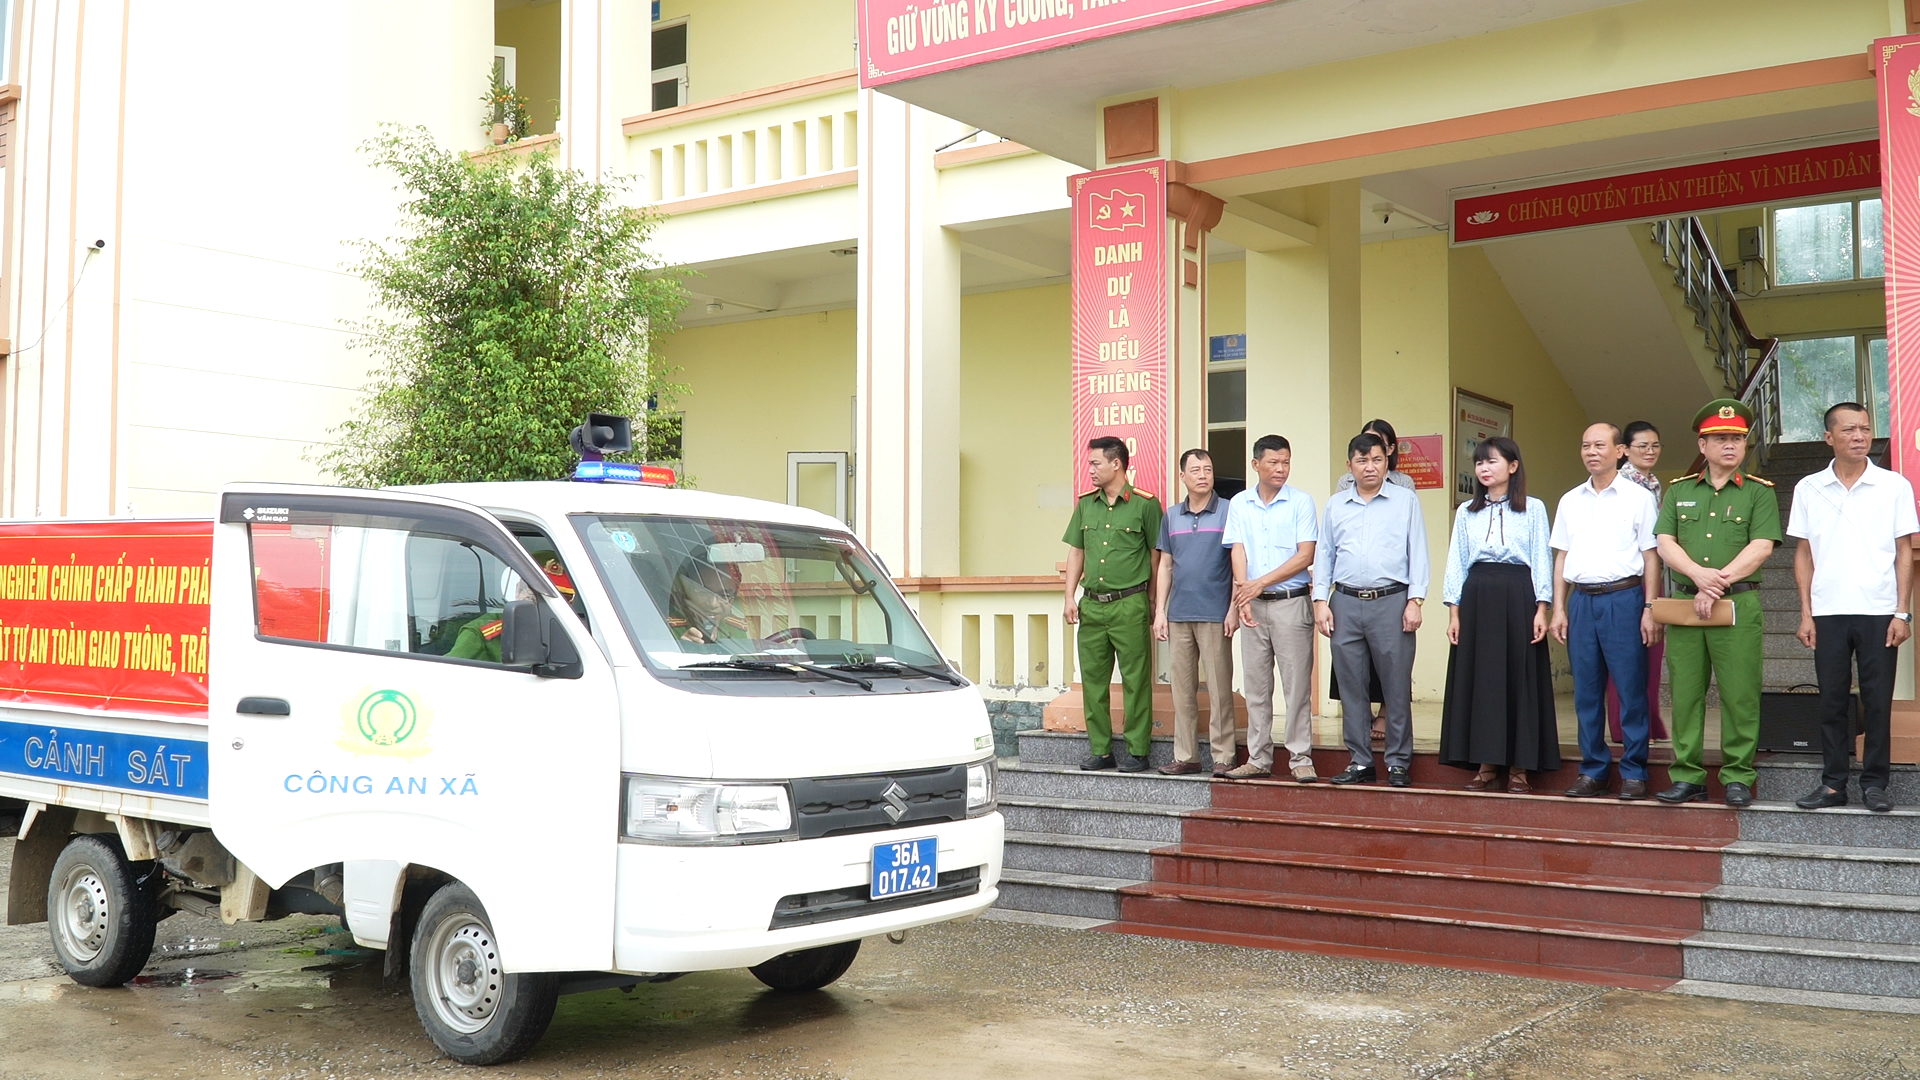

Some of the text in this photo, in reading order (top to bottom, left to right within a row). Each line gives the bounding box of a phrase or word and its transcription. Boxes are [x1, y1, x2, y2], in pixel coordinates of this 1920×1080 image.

[887, 4, 918, 55] GIỮ
[1508, 197, 1563, 222] CHÍNH
[1568, 182, 1627, 217] QUYỀN
[1631, 178, 1680, 205] THÂN
[1684, 169, 1744, 198] THIỆN,
[1750, 164, 1770, 189] VÌ
[1774, 157, 1828, 187] NHÂN
[1832, 152, 1872, 179] DÂN
[1094, 241, 1143, 266] DANH
[1107, 273, 1132, 300] DỰ
[1108, 304, 1131, 329] LÀ
[1098, 334, 1140, 362] ĐIỀU
[1088, 370, 1151, 394] THIÊNG
[1093, 402, 1145, 426] LIÊNG
[256, 507, 289, 515] SUZUKI
[0, 557, 49, 600] NGHIÊM
[51, 553, 93, 601] CHỈNH
[95, 552, 133, 602] CHẤP
[135, 557, 177, 604] HÀNH
[178, 557, 211, 604] PHÁ
[13, 624, 30, 671] TỰ
[29, 628, 49, 664] AN
[52, 622, 86, 666] TOÀN
[88, 630, 120, 668] GIAO
[124, 624, 177, 677] THÔNG,
[181, 626, 210, 683] TRẬ
[24, 729, 191, 787] CẢNH SÁT
[283, 769, 479, 796] CÔNG AN XÃ
[891, 841, 920, 867] 36A
[879, 864, 931, 895] 017.42
